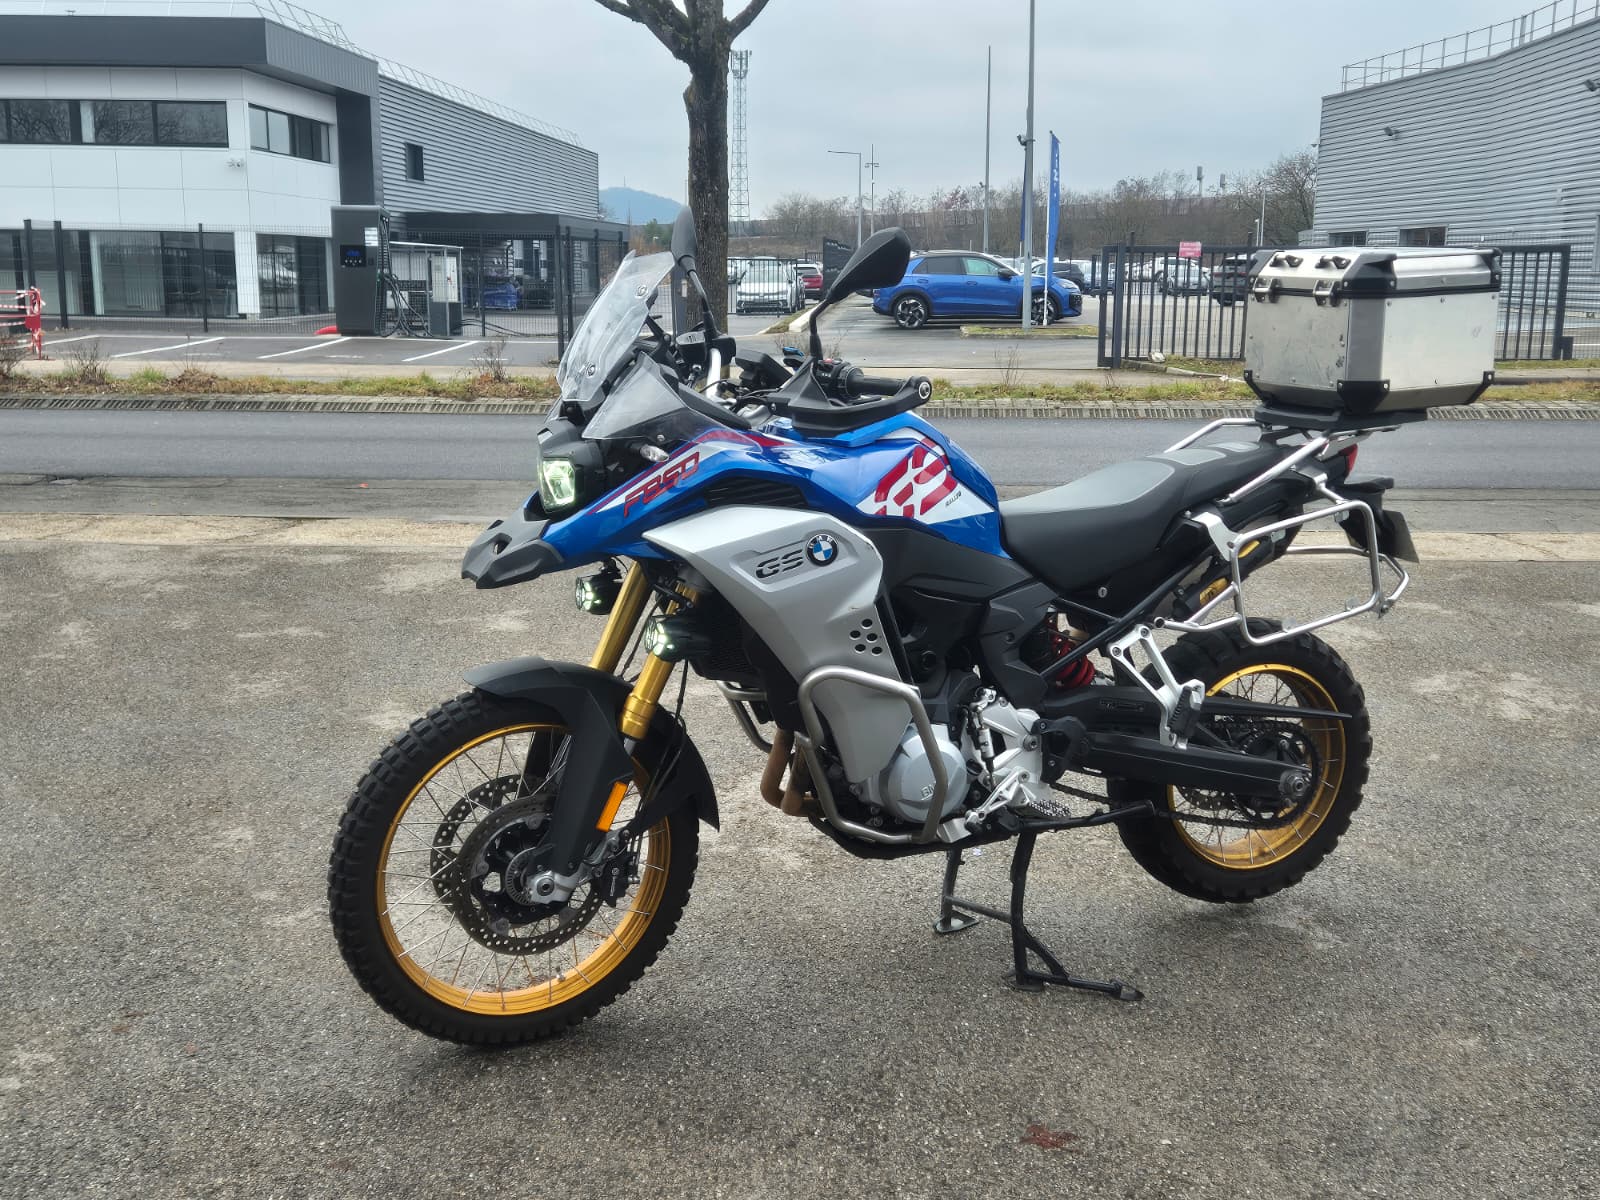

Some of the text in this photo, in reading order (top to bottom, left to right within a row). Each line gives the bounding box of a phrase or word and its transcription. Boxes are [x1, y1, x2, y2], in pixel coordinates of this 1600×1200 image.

[624, 452, 700, 518] F850
[756, 549, 804, 578] GS
[920, 784, 935, 799] BM
